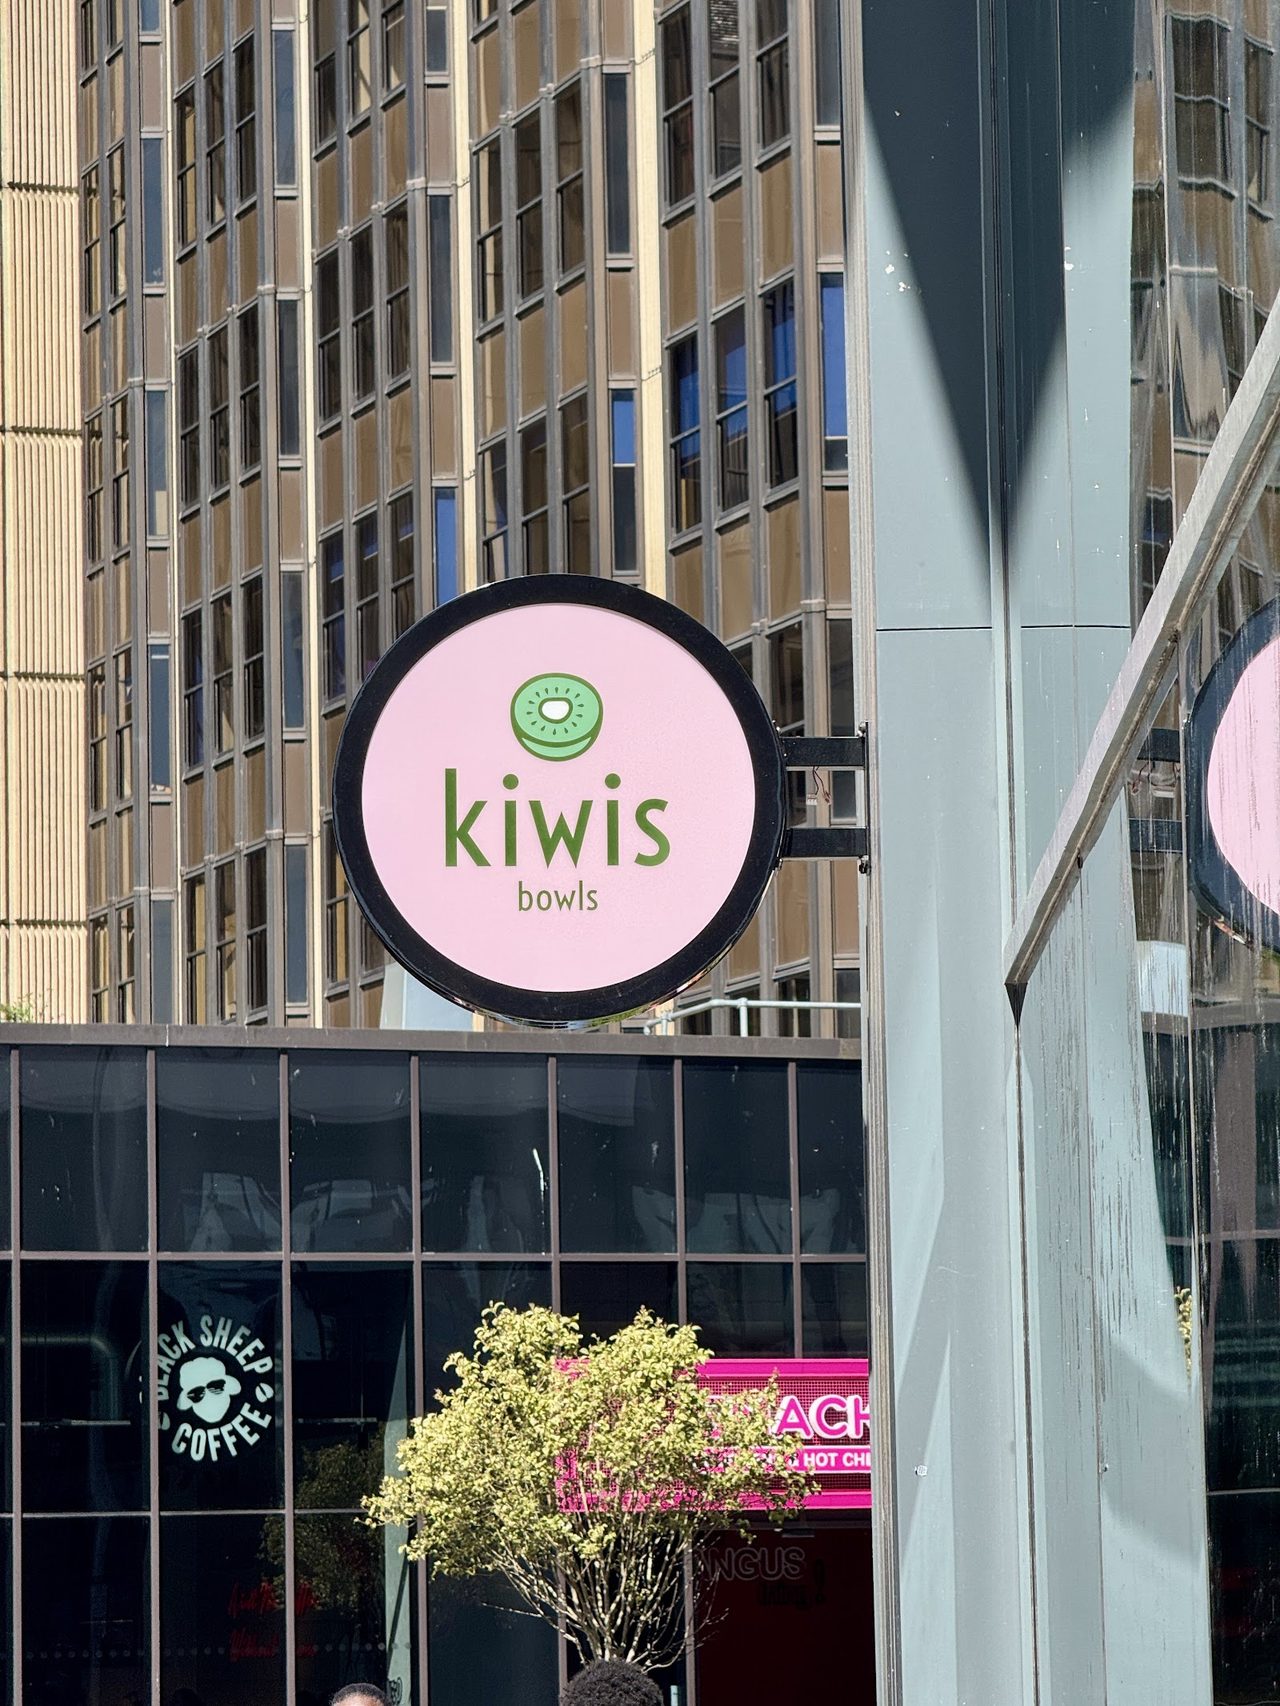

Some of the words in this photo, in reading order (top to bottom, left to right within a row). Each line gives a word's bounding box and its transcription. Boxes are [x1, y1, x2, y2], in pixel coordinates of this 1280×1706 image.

[444, 767, 671, 869] kiwis
[518, 880, 598, 911] bowls
[199, 1314, 274, 1375] SHEEP
[171, 1402, 273, 1462] COFFEE
[803, 1452, 839, 1467] HOT
